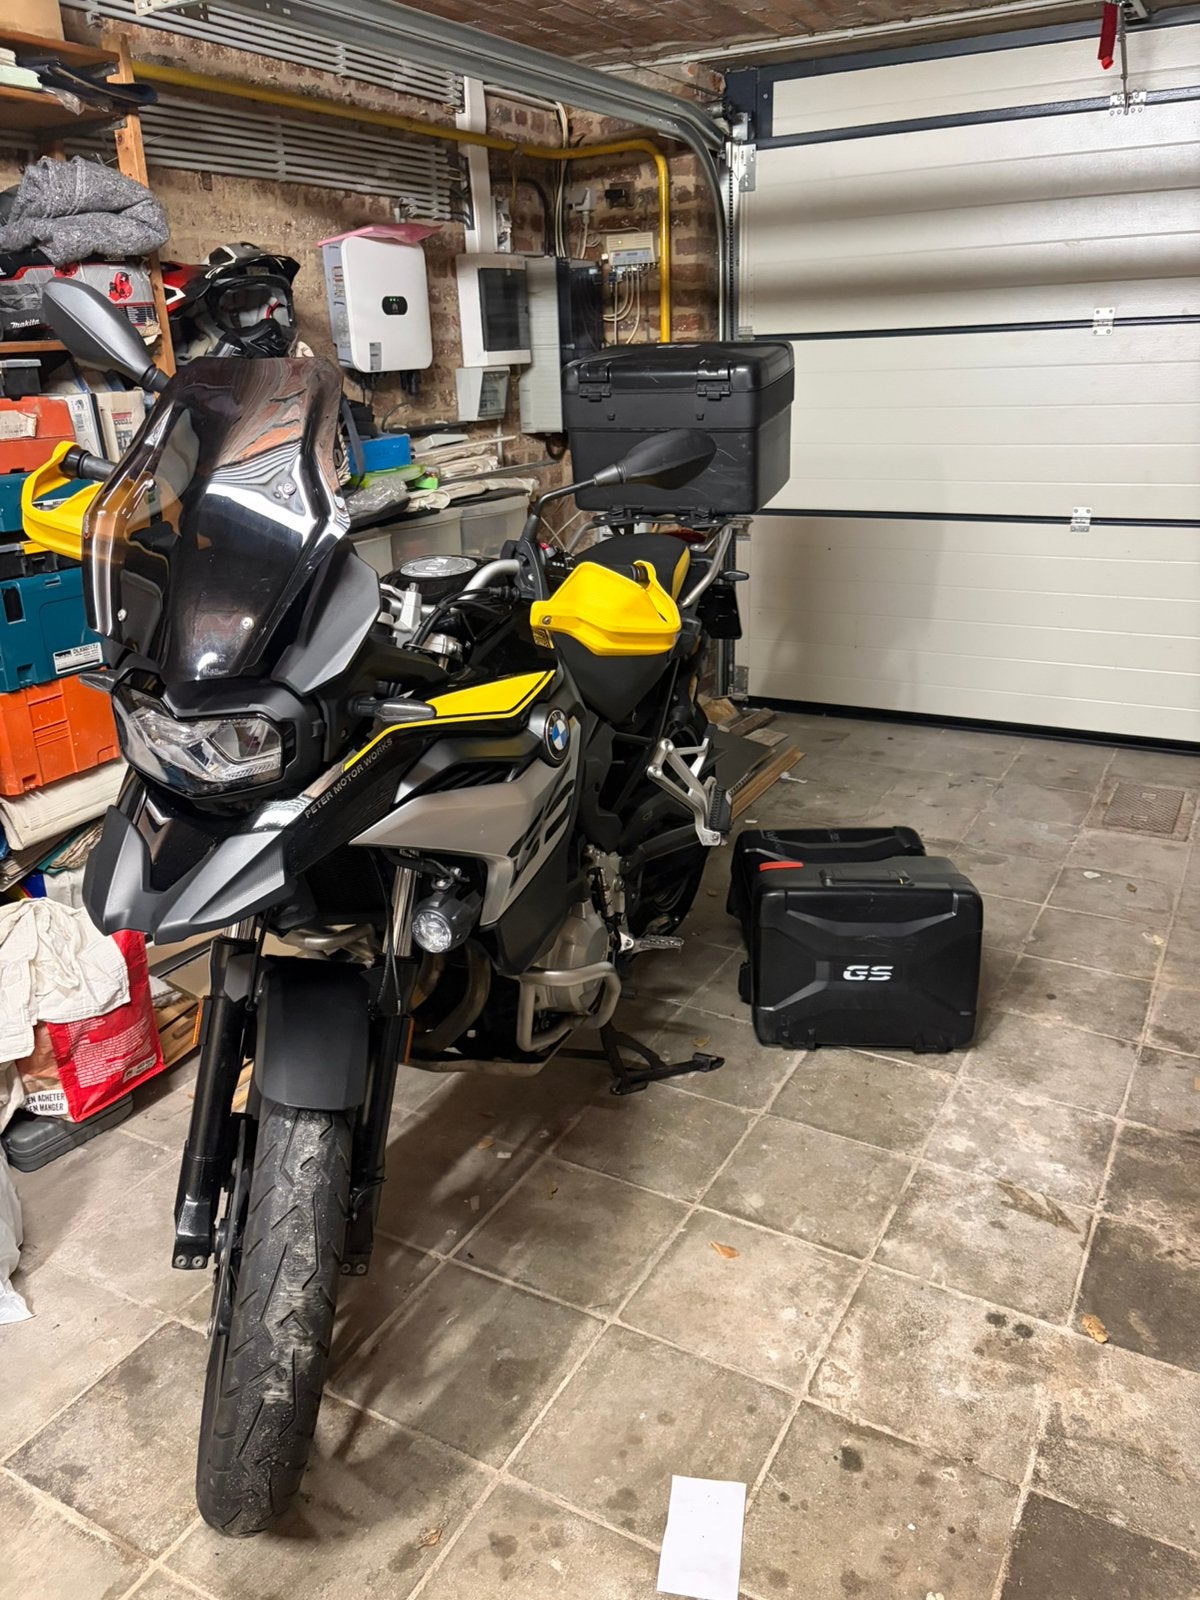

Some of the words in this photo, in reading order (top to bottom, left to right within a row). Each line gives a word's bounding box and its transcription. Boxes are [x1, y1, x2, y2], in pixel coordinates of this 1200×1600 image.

[304, 791, 334, 819] PETER
[333, 764, 364, 795] MOTOR
[363, 737, 393, 767] WORKS
[843, 965, 894, 981] GS
[26, 1095, 37, 1105] EN
[38, 1092, 65, 1102] ACHETER
[39, 1102, 65, 1112] MANGER
